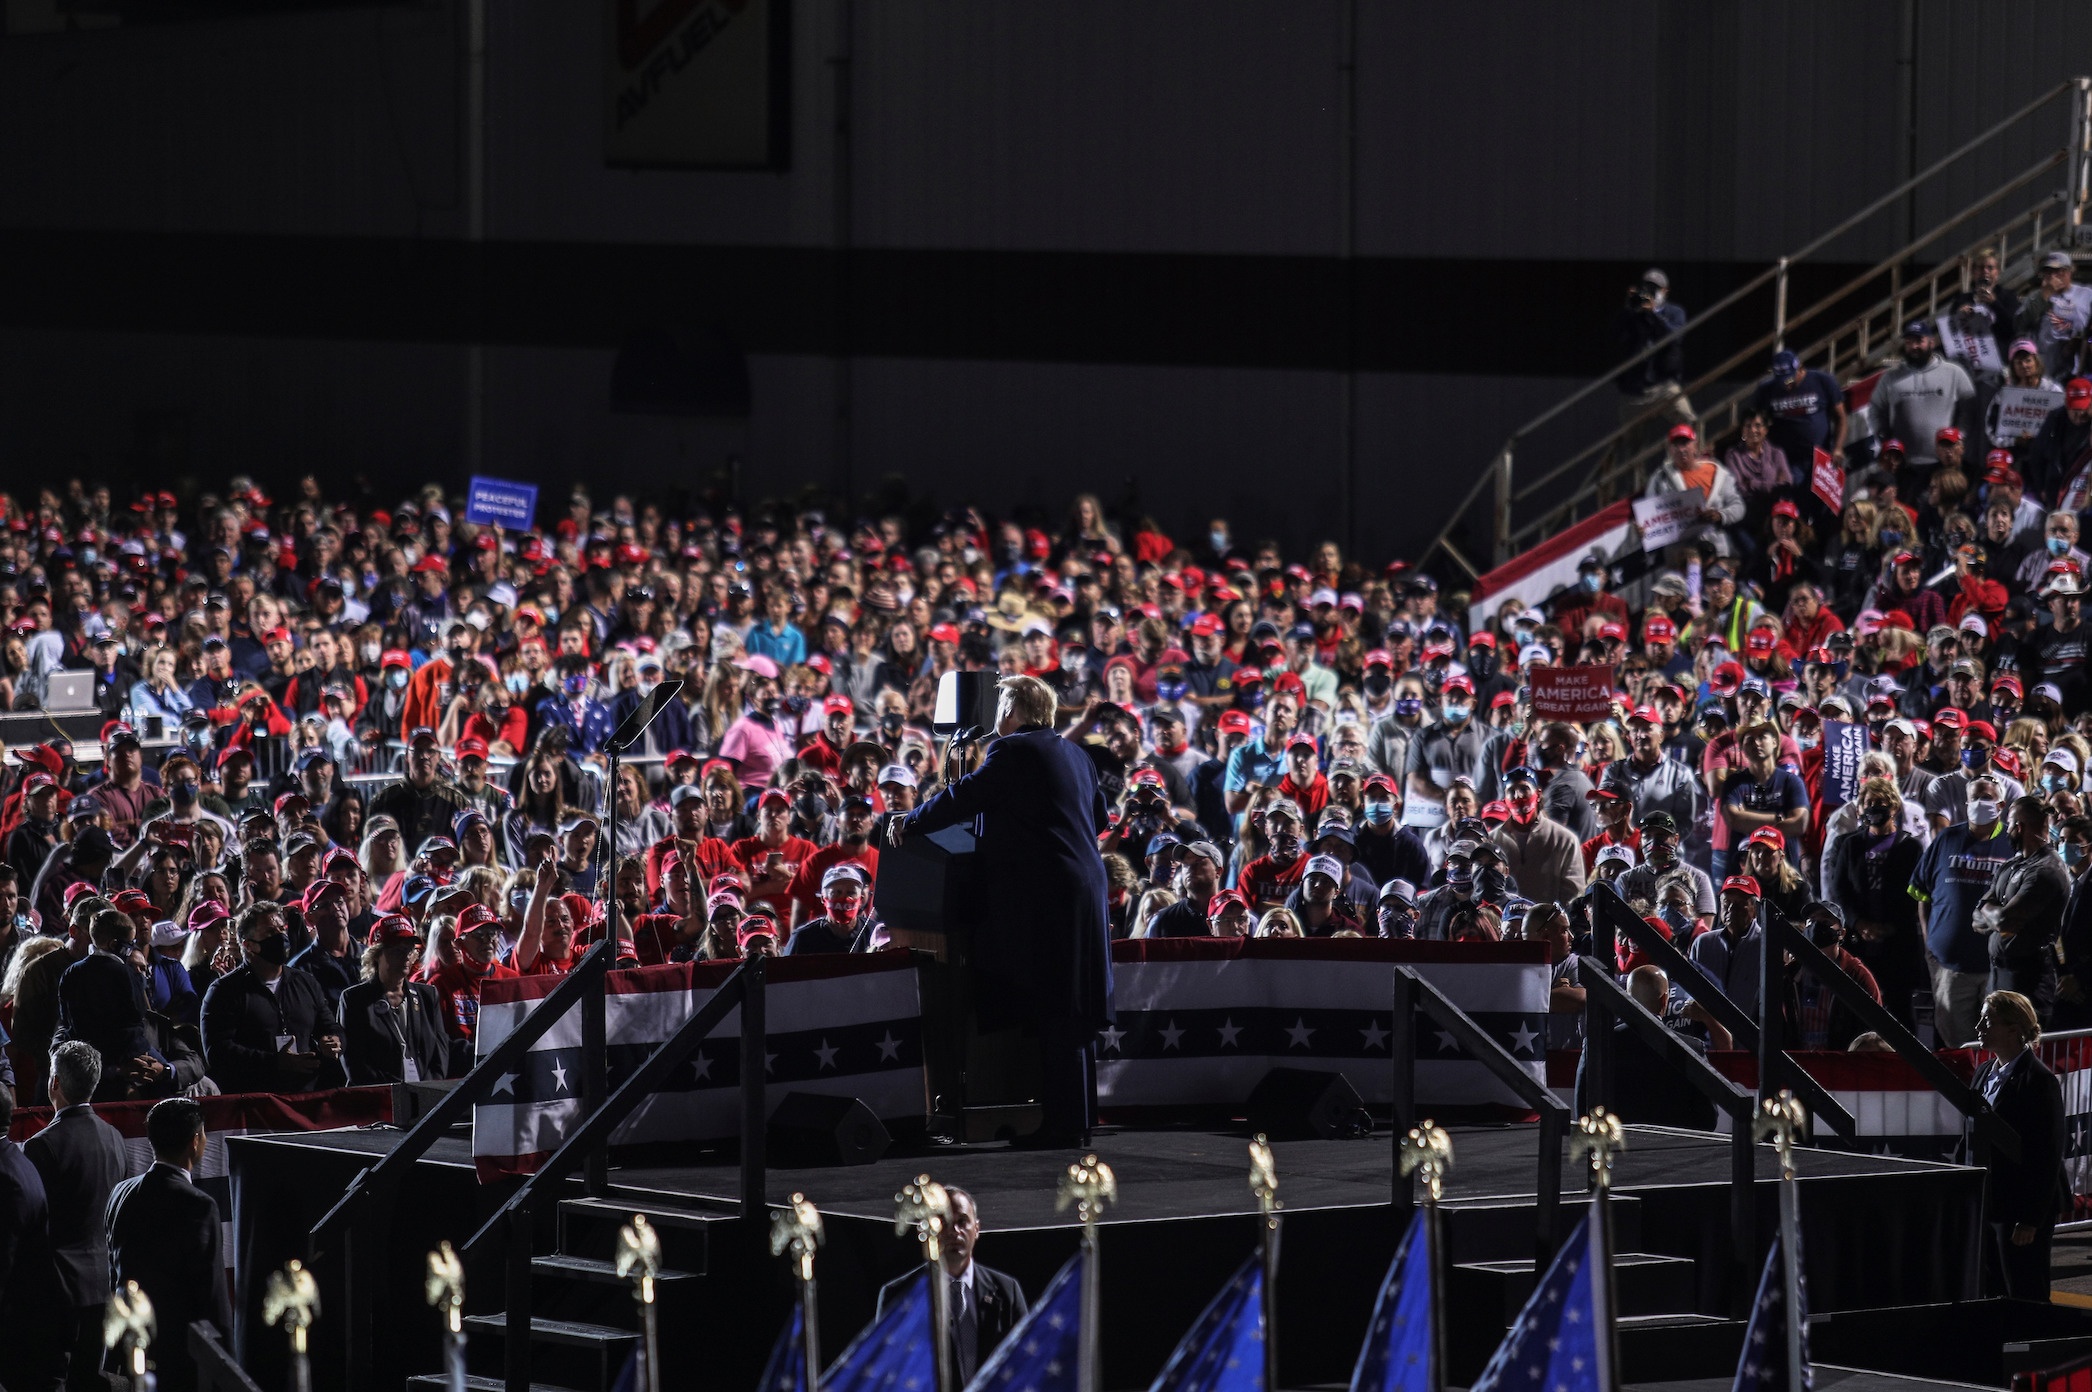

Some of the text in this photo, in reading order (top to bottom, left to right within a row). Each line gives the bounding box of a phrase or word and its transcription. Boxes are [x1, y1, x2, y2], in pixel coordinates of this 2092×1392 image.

[616, 3, 731, 131] AVFUEL
[2022, 397, 2050, 406] MAKE
[2004, 405, 2047, 420] AMERI
[1554, 675, 1590, 686] MAKE
[1535, 683, 1611, 701] AMERICA
[1534, 700, 1612, 713] GREAT AGAIN
[1831, 744, 1841, 780] MAKE
[1840, 725, 1855, 803] AMERICA
[1428, 806, 1444, 815] AGA
